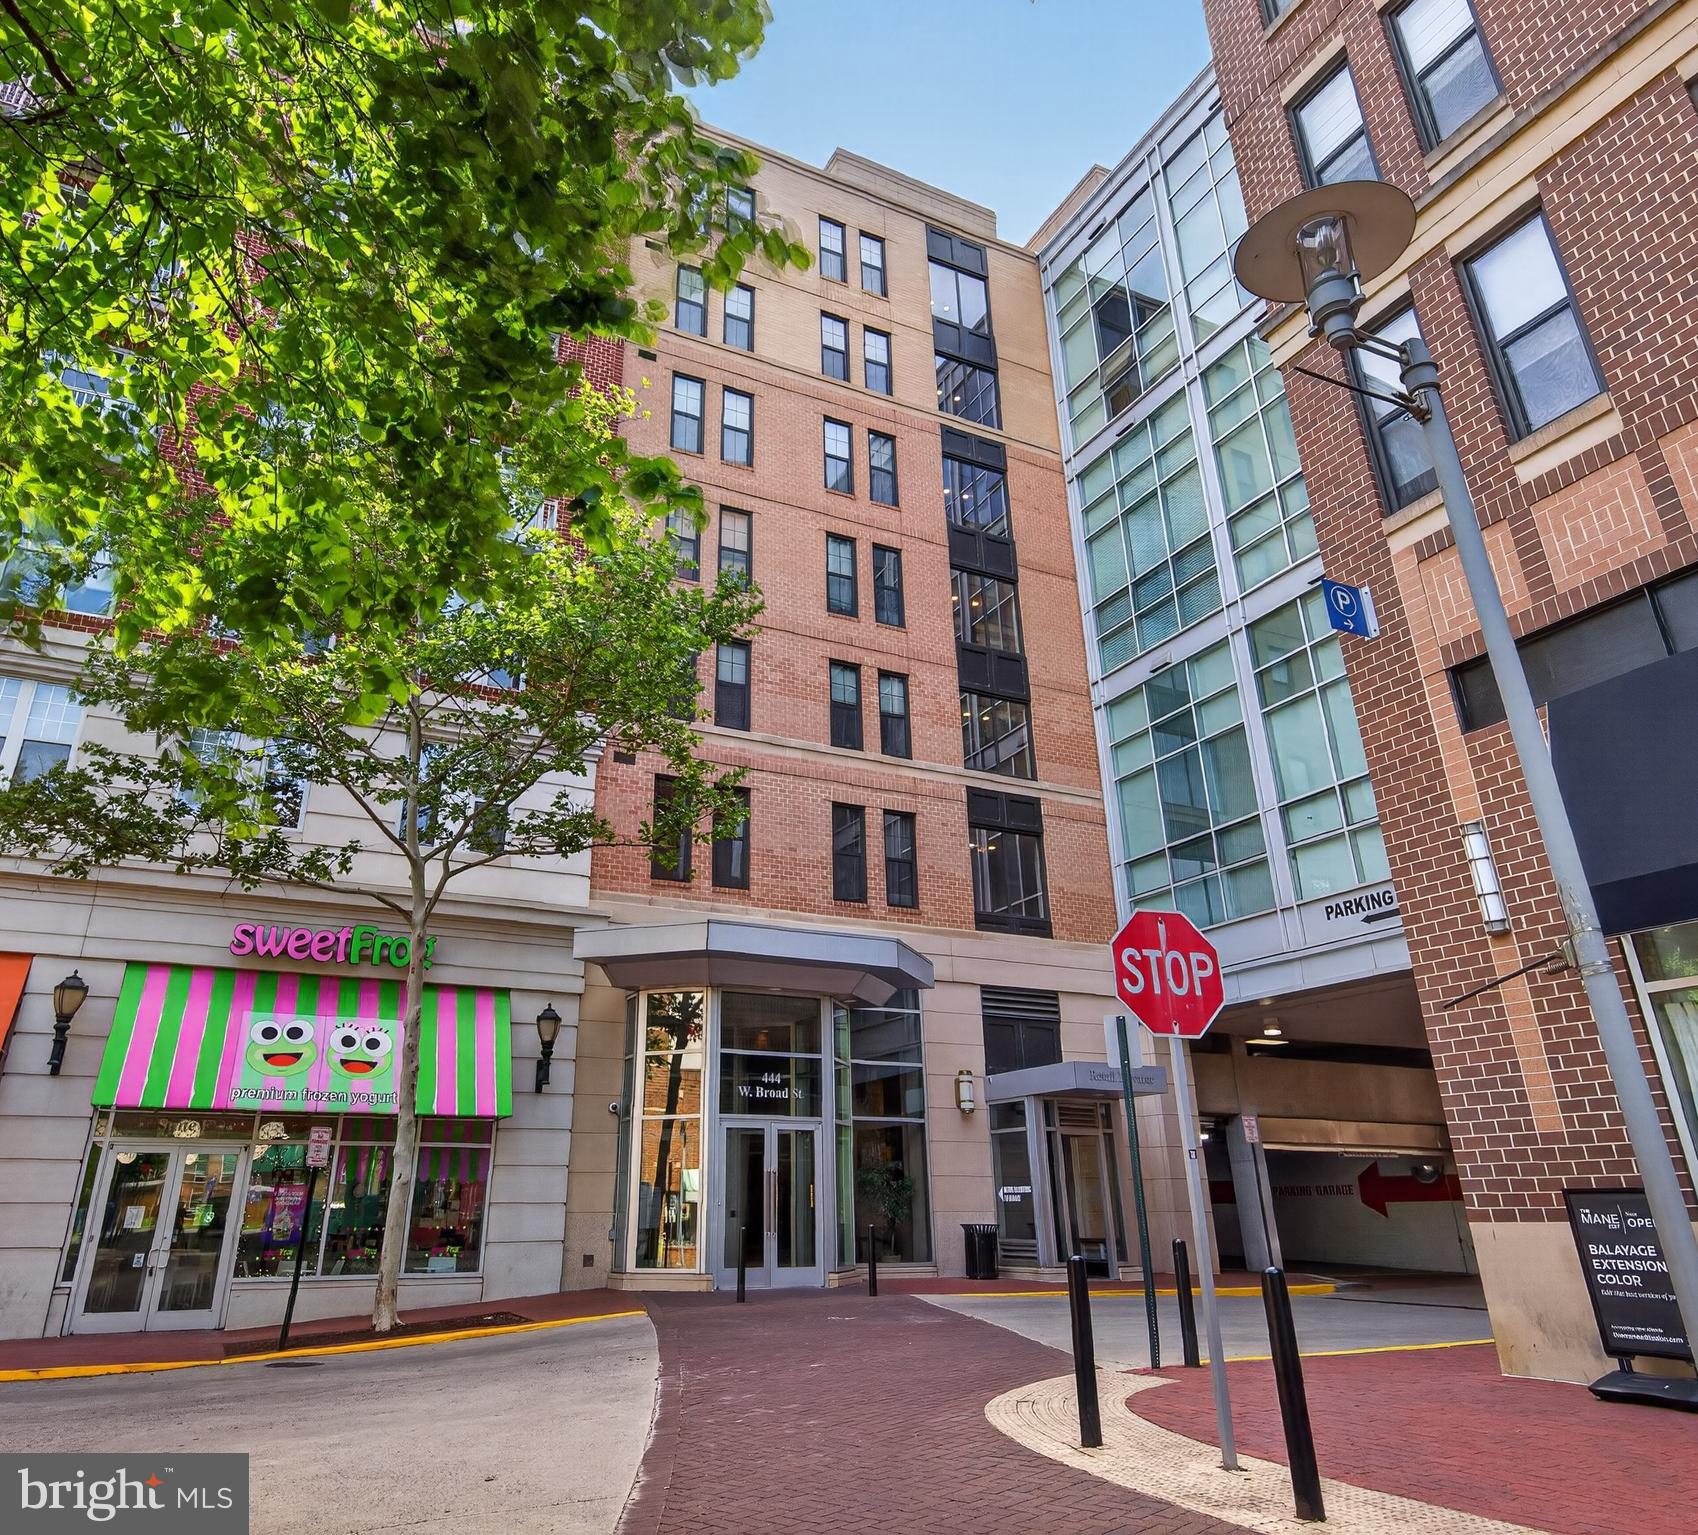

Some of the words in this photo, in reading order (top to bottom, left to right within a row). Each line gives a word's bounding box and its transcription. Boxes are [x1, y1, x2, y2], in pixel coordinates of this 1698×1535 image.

[1324, 889, 1394, 921] PARKING
[1121, 947, 1214, 997] STOP
[761, 1072, 781, 1084] 444
[231, 1086, 298, 1101] premium
[301, 1087, 348, 1103] frozen
[351, 1089, 399, 1106] yogurt
[738, 1086, 753, 1097] W.
[756, 1086, 789, 1099] Broad
[1580, 1213, 1620, 1225] MANE
[1588, 1244, 1658, 1257] BALAYAGE
[1597, 1273, 1643, 1287] COLOR
